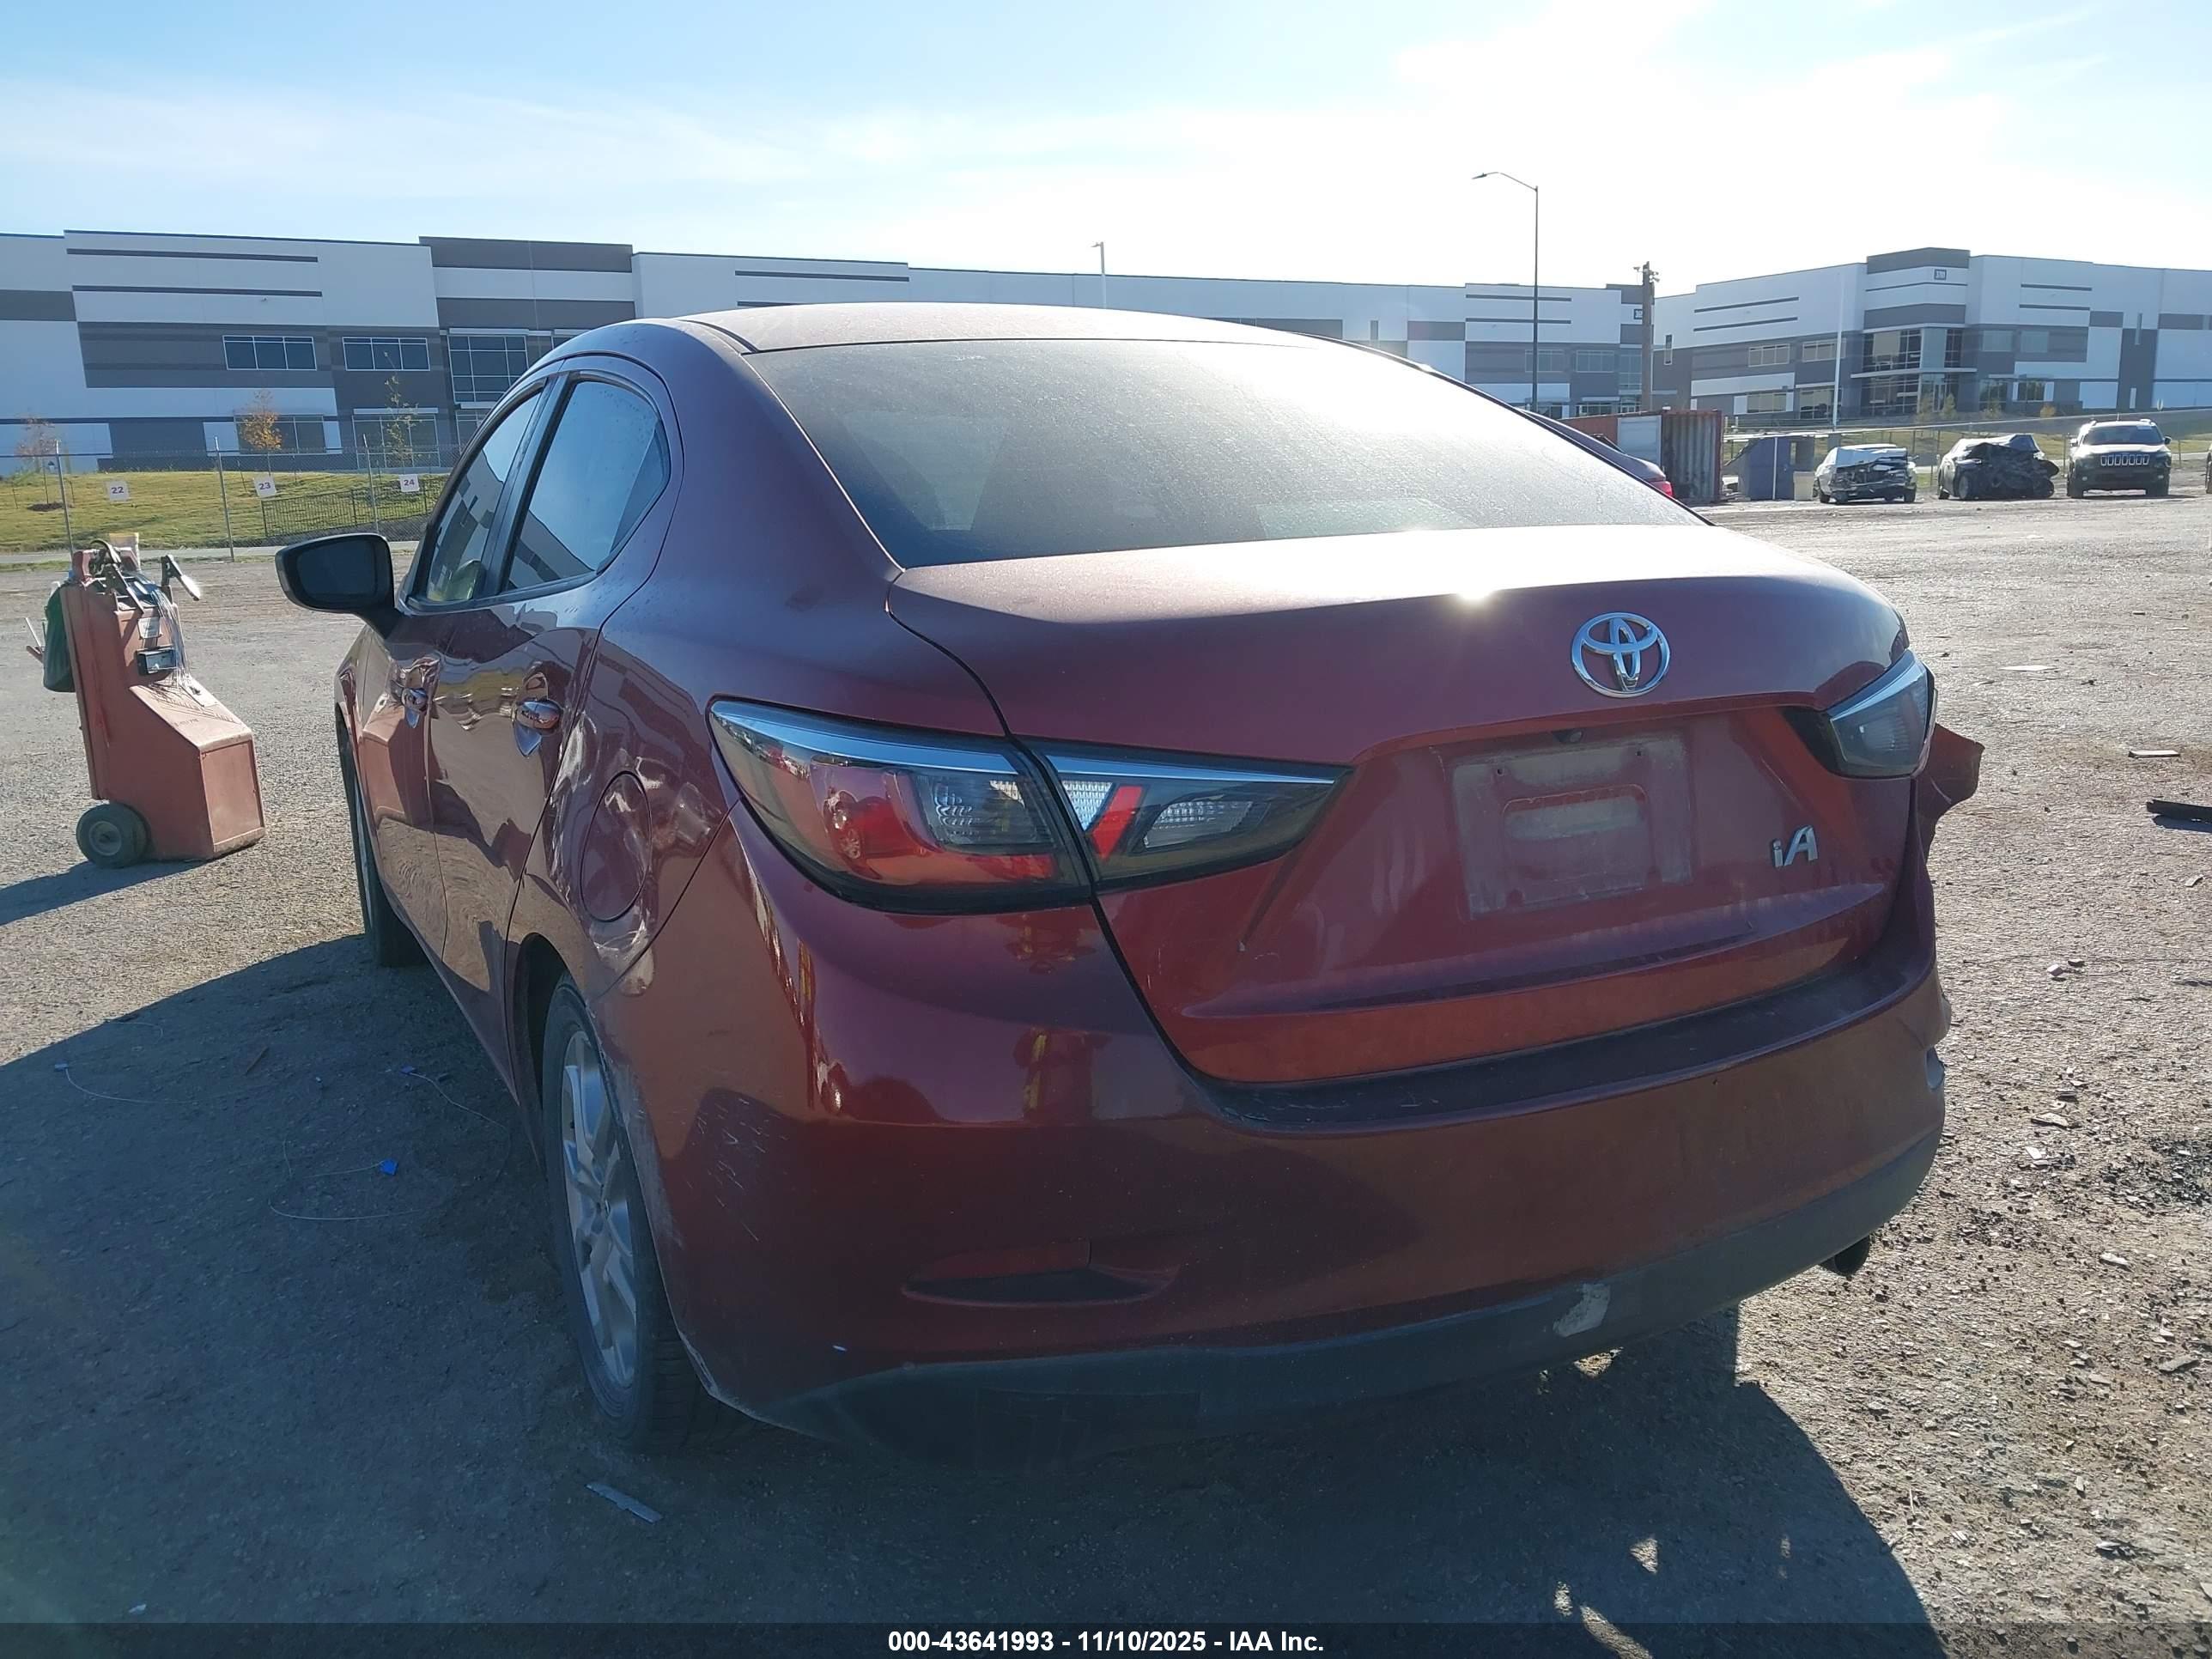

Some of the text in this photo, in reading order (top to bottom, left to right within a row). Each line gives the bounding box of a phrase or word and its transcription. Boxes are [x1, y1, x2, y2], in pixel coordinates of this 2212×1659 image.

[111, 486, 125, 495] 22
[258, 482, 271, 490] 23
[1772, 824, 1819, 867] iA
